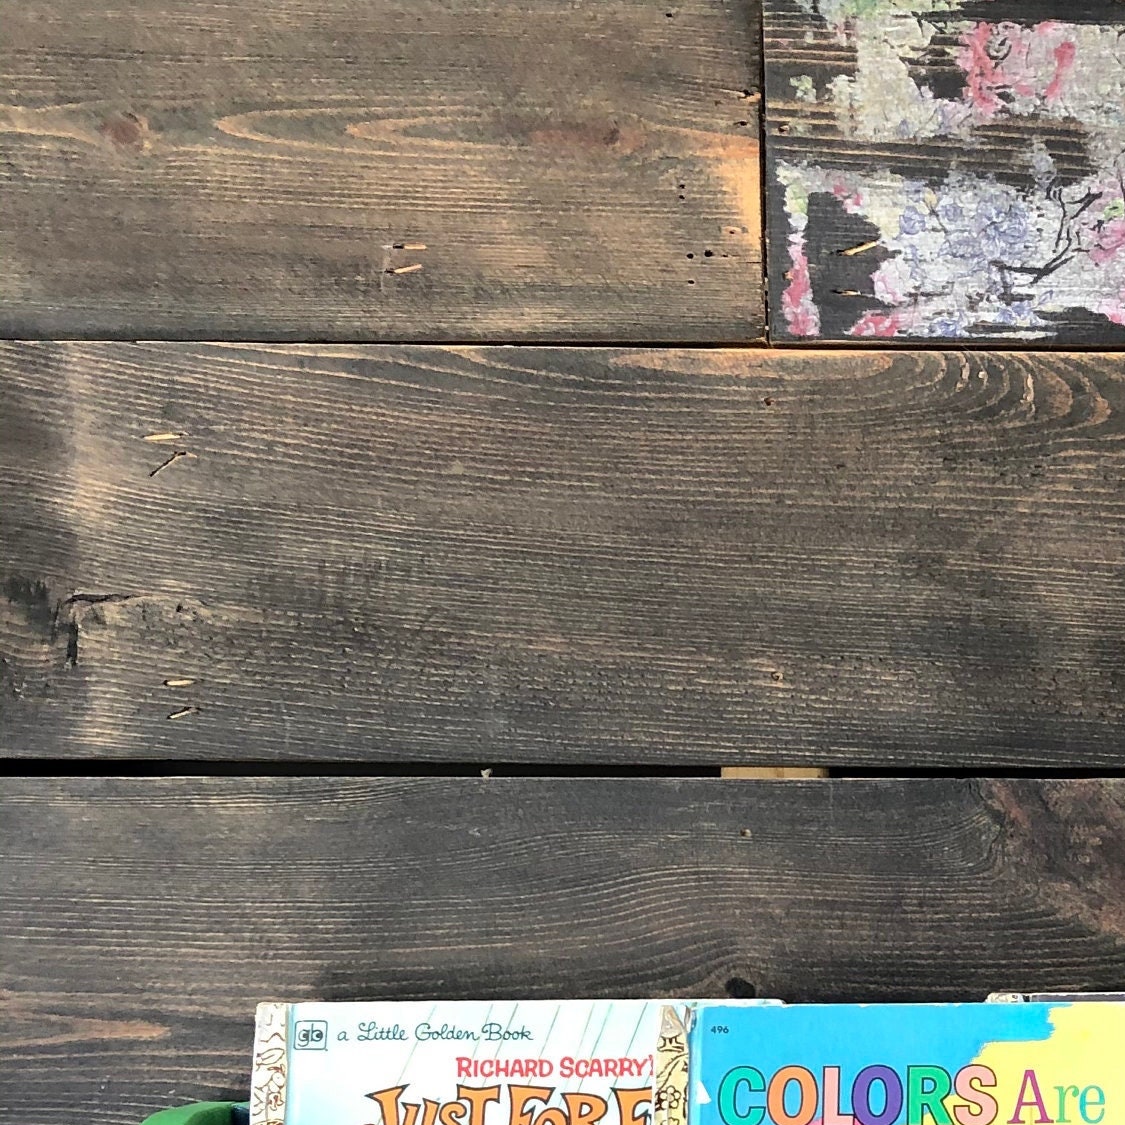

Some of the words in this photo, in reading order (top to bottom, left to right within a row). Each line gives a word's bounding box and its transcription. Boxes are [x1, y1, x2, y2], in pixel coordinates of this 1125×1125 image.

[337, 1032, 350, 1042] a
[357, 1021, 409, 1041] Little
[414, 1022, 480, 1041] Golden
[481, 1022, 534, 1041] Book
[710, 1025, 730, 1035] 496
[456, 1056, 554, 1078] RICHARD
[1006, 1069, 1106, 1125] Are
